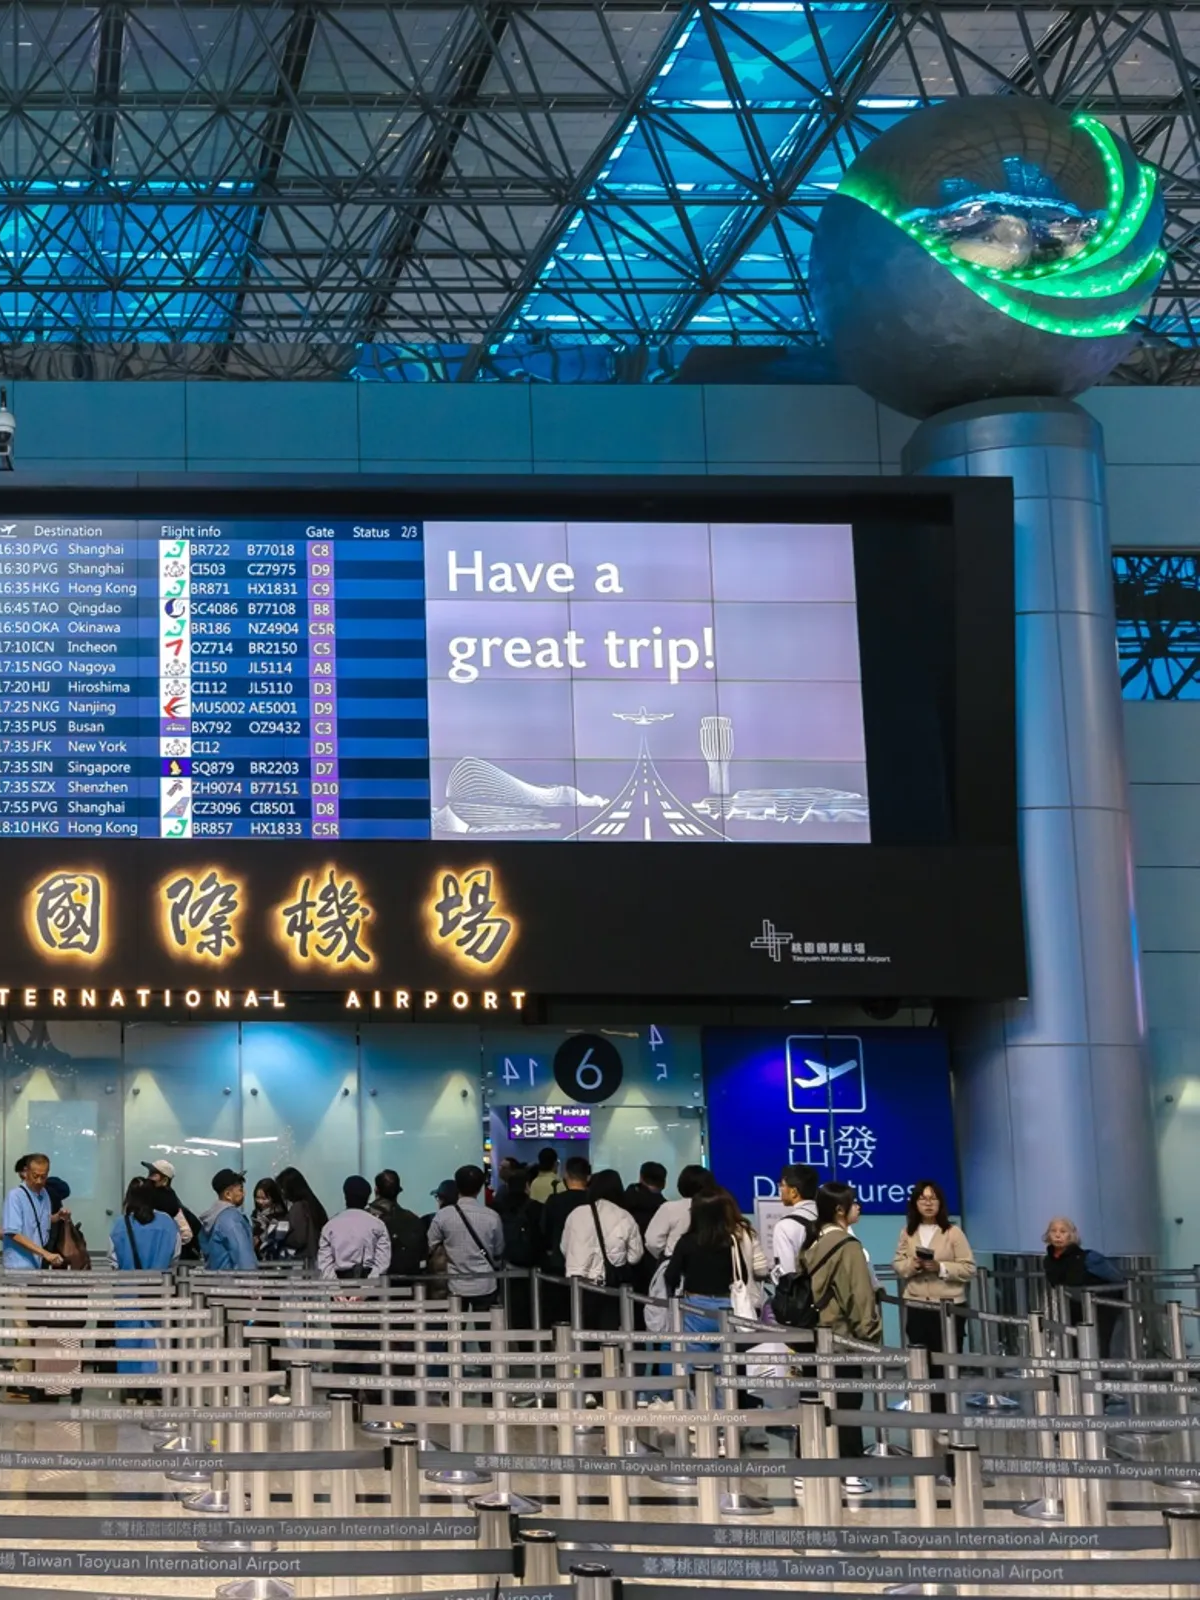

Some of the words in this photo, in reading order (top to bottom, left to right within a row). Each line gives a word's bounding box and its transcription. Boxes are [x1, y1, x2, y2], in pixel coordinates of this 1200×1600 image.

[34, 525, 102, 537] Destination
[160, 525, 194, 541] Flight
[196, 525, 222, 538] info
[306, 525, 334, 538] Gate
[352, 526, 390, 538] Status
[32, 562, 58, 574] PVG
[68, 562, 124, 578] Shanghai
[190, 562, 226, 576] CI503
[246, 563, 296, 576] CZ7975
[312, 563, 330, 576] D9
[447, 550, 575, 593] Have
[594, 562, 624, 593] a
[32, 601, 60, 614] TAO
[68, 602, 122, 618] Qingdao
[190, 602, 238, 615] SC4086
[248, 602, 296, 615] B77108
[312, 603, 330, 616] B8
[448, 630, 586, 683] great
[604, 626, 715, 684] trip!
[30, 660, 62, 673] NGO
[68, 661, 116, 677] Nagoya
[190, 661, 228, 674] CI150
[248, 661, 292, 674] JL5114
[314, 662, 332, 675] A8
[30, 700, 60, 713] NKG
[68, 700, 116, 716] Nanjing
[192, 701, 246, 714] MU5002
[248, 701, 298, 714] AE5001
[314, 702, 334, 715] D9
[30, 760, 54, 773] SIN
[68, 761, 132, 777] Singapore
[190, 761, 236, 775] SQ879
[250, 761, 300, 775] BR2203
[316, 762, 334, 775] D7
[30, 820, 60, 833] HKG
[68, 821, 100, 837] Hong
[104, 821, 138, 837] Kong
[192, 822, 234, 835] BR857
[250, 822, 302, 835] HX1833
[312, 822, 340, 835] C5R
[346, 991, 527, 1010] AIRPORT
[575, 1048, 603, 1090] 6
[788, 1124, 878, 1169] 出發
[908, 1381, 936, 1392] Airport
[578, 1459, 617, 1470] Taiwan
[620, 1460, 667, 1473] Taoyuan
[670, 1461, 743, 1473] International
[745, 1462, 786, 1475] Airport
[227, 1522, 275, 1536] Taiwan
[279, 1522, 336, 1538] Taoyuan
[340, 1522, 430, 1536] International
[433, 1522, 478, 1538] Airpor
[840, 1530, 889, 1544] Taiwan
[893, 1532, 952, 1548] Taoyuan
[955, 1532, 1045, 1546] International
[1048, 1532, 1099, 1548] Airport
[19, 1553, 71, 1568] Taiwan
[76, 1553, 141, 1573] Taoyuan
[145, 1555, 242, 1571] International
[245, 1557, 300, 1573] Airport
